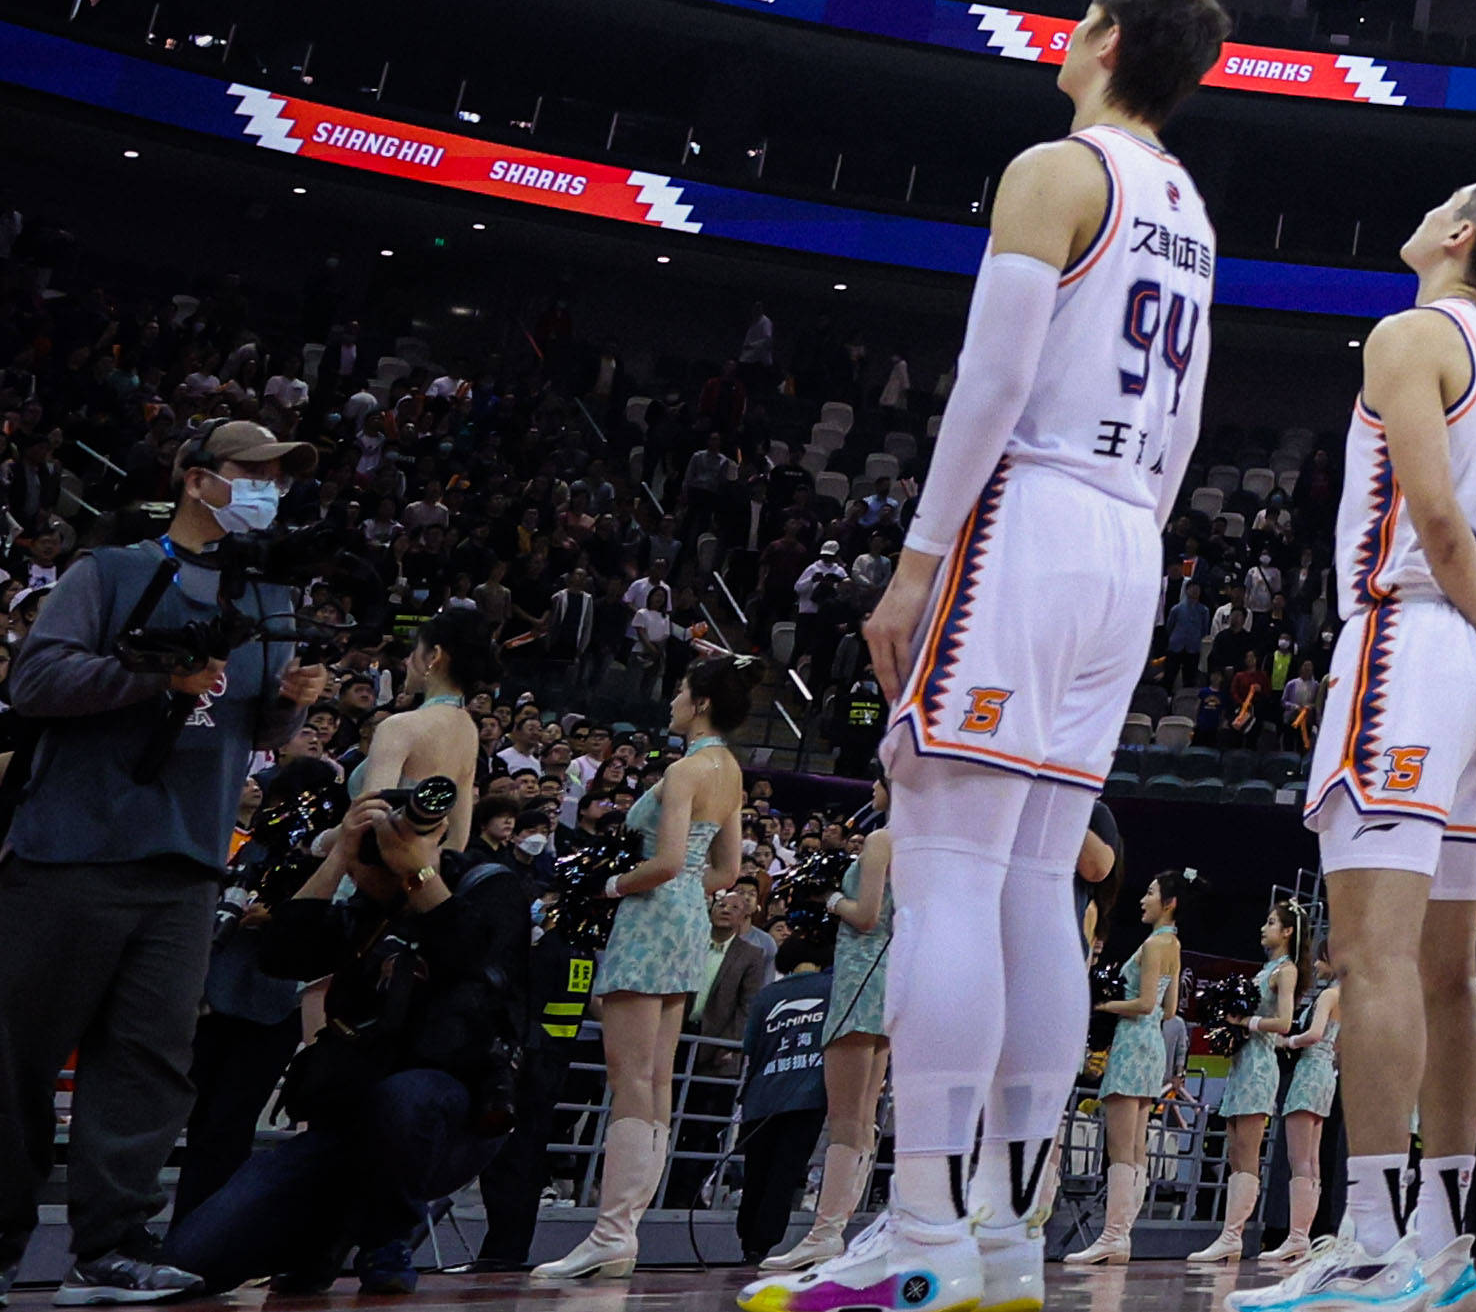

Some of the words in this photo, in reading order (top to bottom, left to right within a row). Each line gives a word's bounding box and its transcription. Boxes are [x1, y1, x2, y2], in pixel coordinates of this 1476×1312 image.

[1224, 54, 1313, 84] SHARKS
[312, 120, 445, 169] SHANGHAI
[489, 159, 588, 197] SHARKS
[1118, 280, 1200, 415] 94
[766, 1011, 825, 1034] LI-NING
